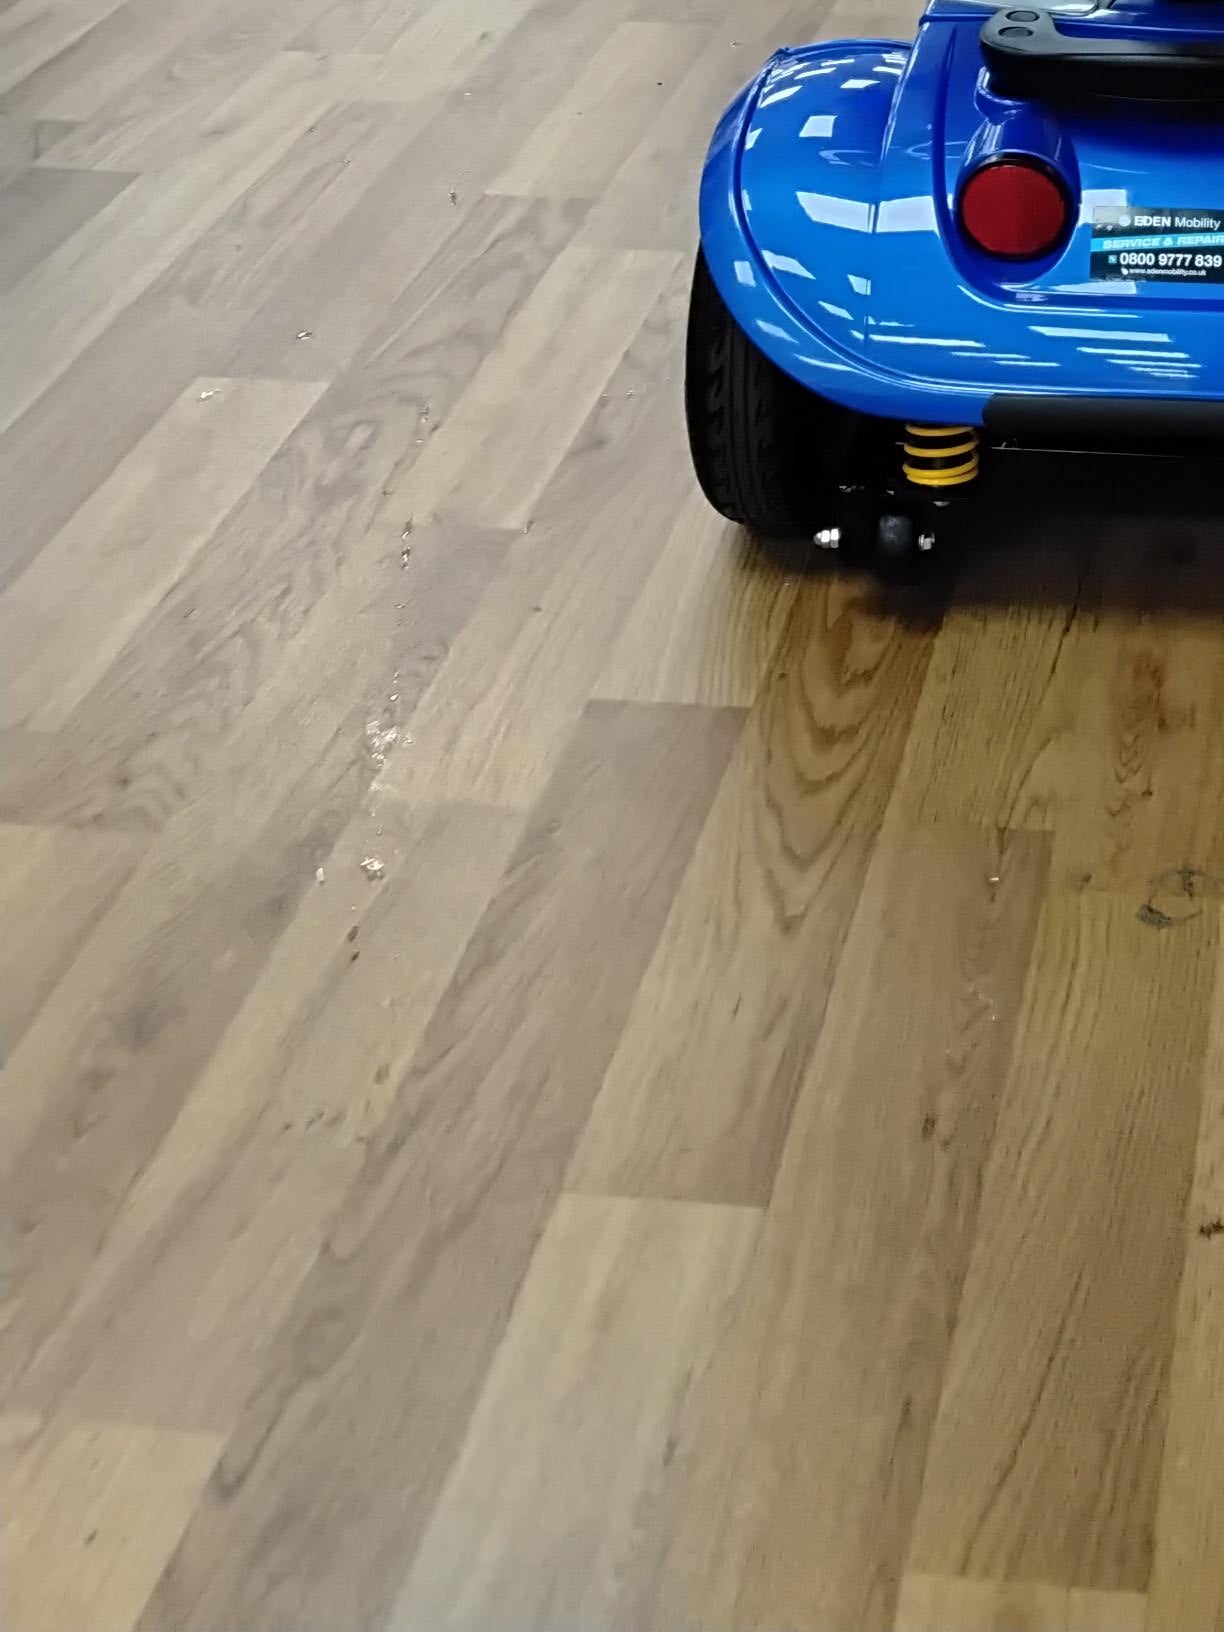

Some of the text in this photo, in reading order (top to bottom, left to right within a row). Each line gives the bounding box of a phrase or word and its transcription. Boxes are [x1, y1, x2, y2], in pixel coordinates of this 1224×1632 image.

[1134, 215, 1221, 231] EDEN Mobility
[1102, 237, 1161, 250] SERVICE
[1163, 236, 1174, 246] &
[1119, 252, 1223, 267] 0800 9777 839
